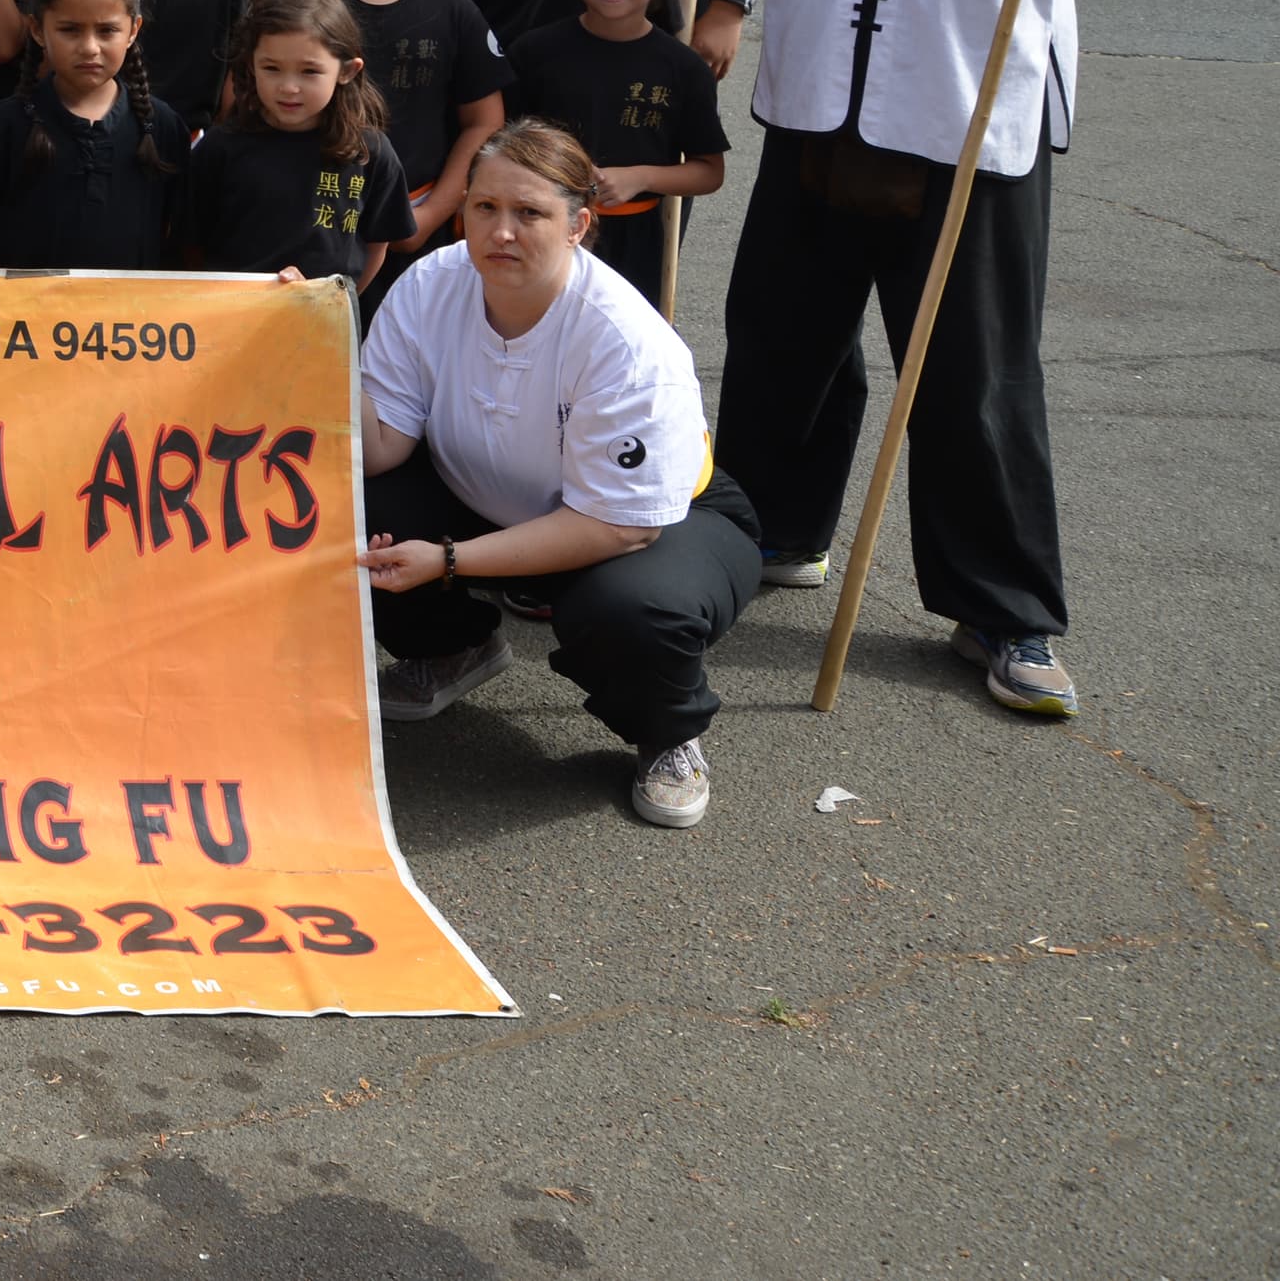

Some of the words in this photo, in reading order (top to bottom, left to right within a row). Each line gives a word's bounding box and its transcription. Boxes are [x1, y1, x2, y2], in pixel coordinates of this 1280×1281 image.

[52, 320, 197, 363] 94590
[76, 412, 319, 557] ARTS
[119, 774, 255, 868] FU
